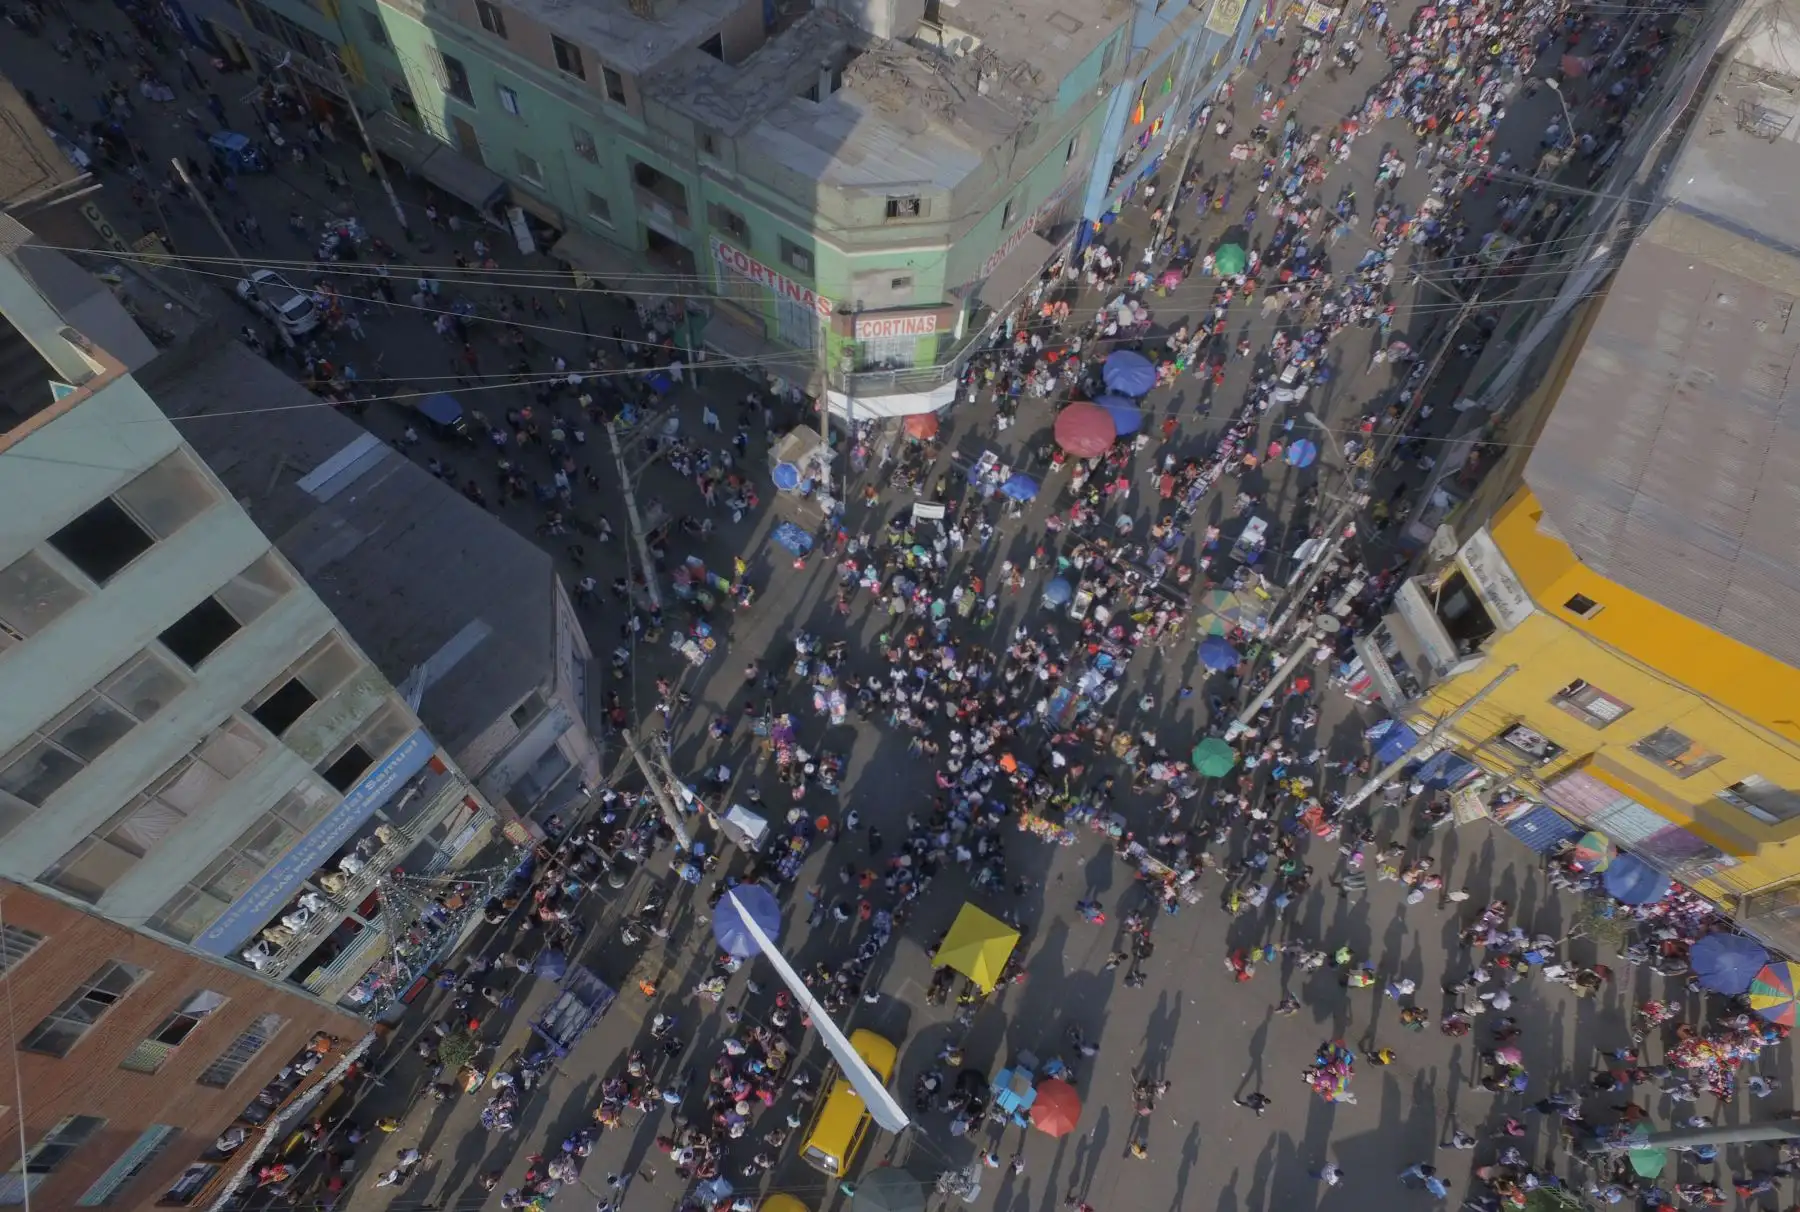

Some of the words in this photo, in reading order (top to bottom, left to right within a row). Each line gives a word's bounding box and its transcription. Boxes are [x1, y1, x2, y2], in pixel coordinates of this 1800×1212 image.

[719, 242, 833, 317] CORTINAS
[862, 316, 935, 337] CORTINAS
[363, 738, 419, 791] Samuel
[249, 872, 295, 914] VENTAS
[315, 813, 355, 851] MAYOR
